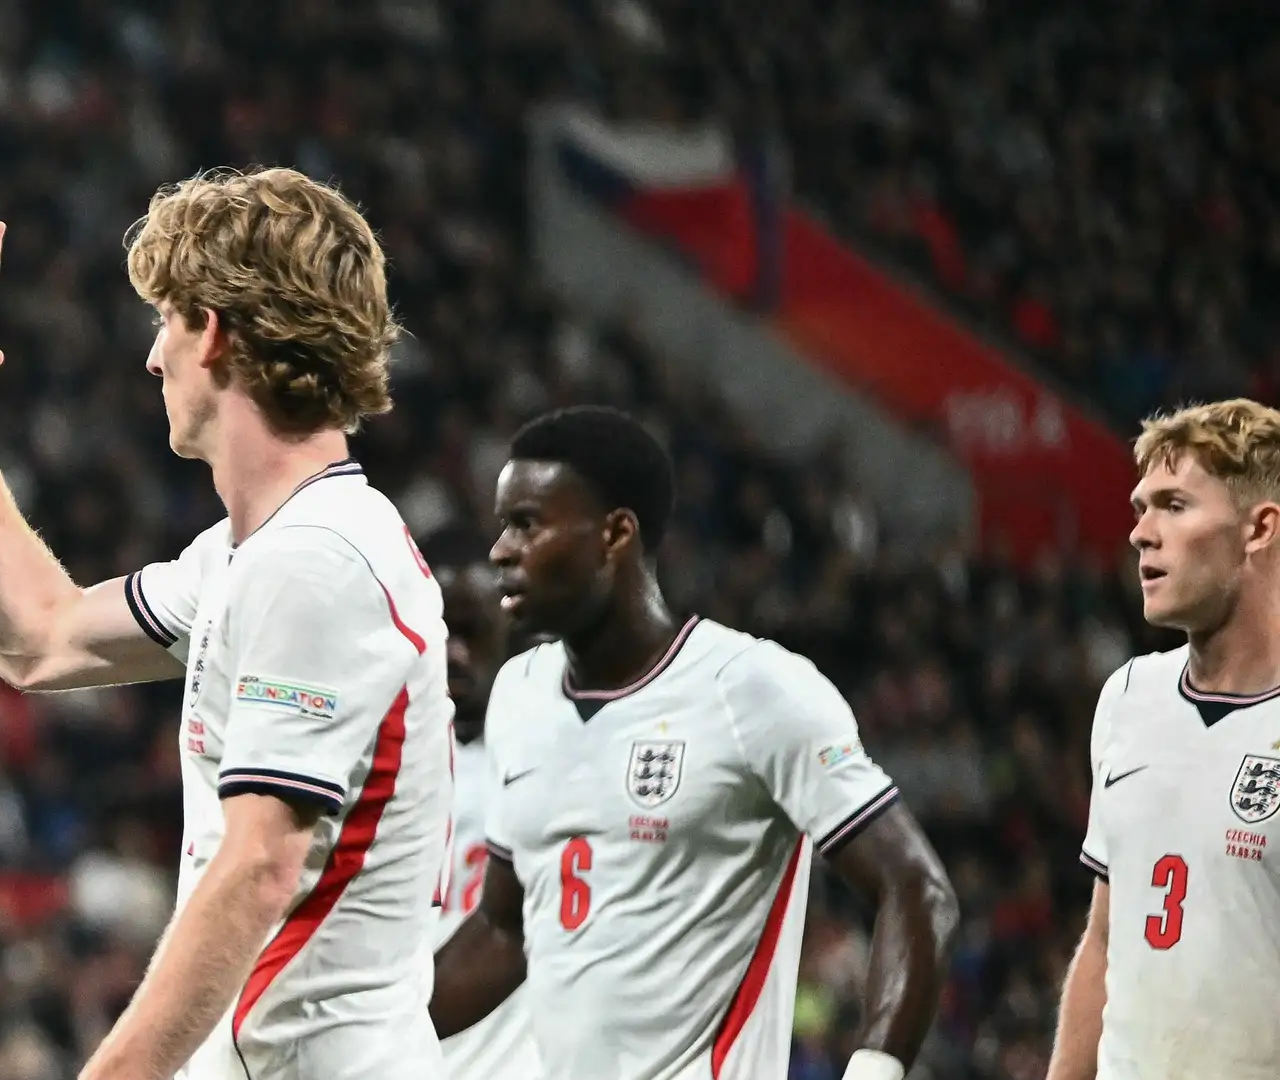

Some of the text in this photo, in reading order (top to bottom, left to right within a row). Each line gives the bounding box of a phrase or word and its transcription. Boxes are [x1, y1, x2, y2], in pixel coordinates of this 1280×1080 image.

[237, 683, 337, 711] FOUNDATION
[1225, 828, 1268, 848] CZECHIA
[559, 836, 593, 933] 6
[1143, 852, 1190, 951] 3
